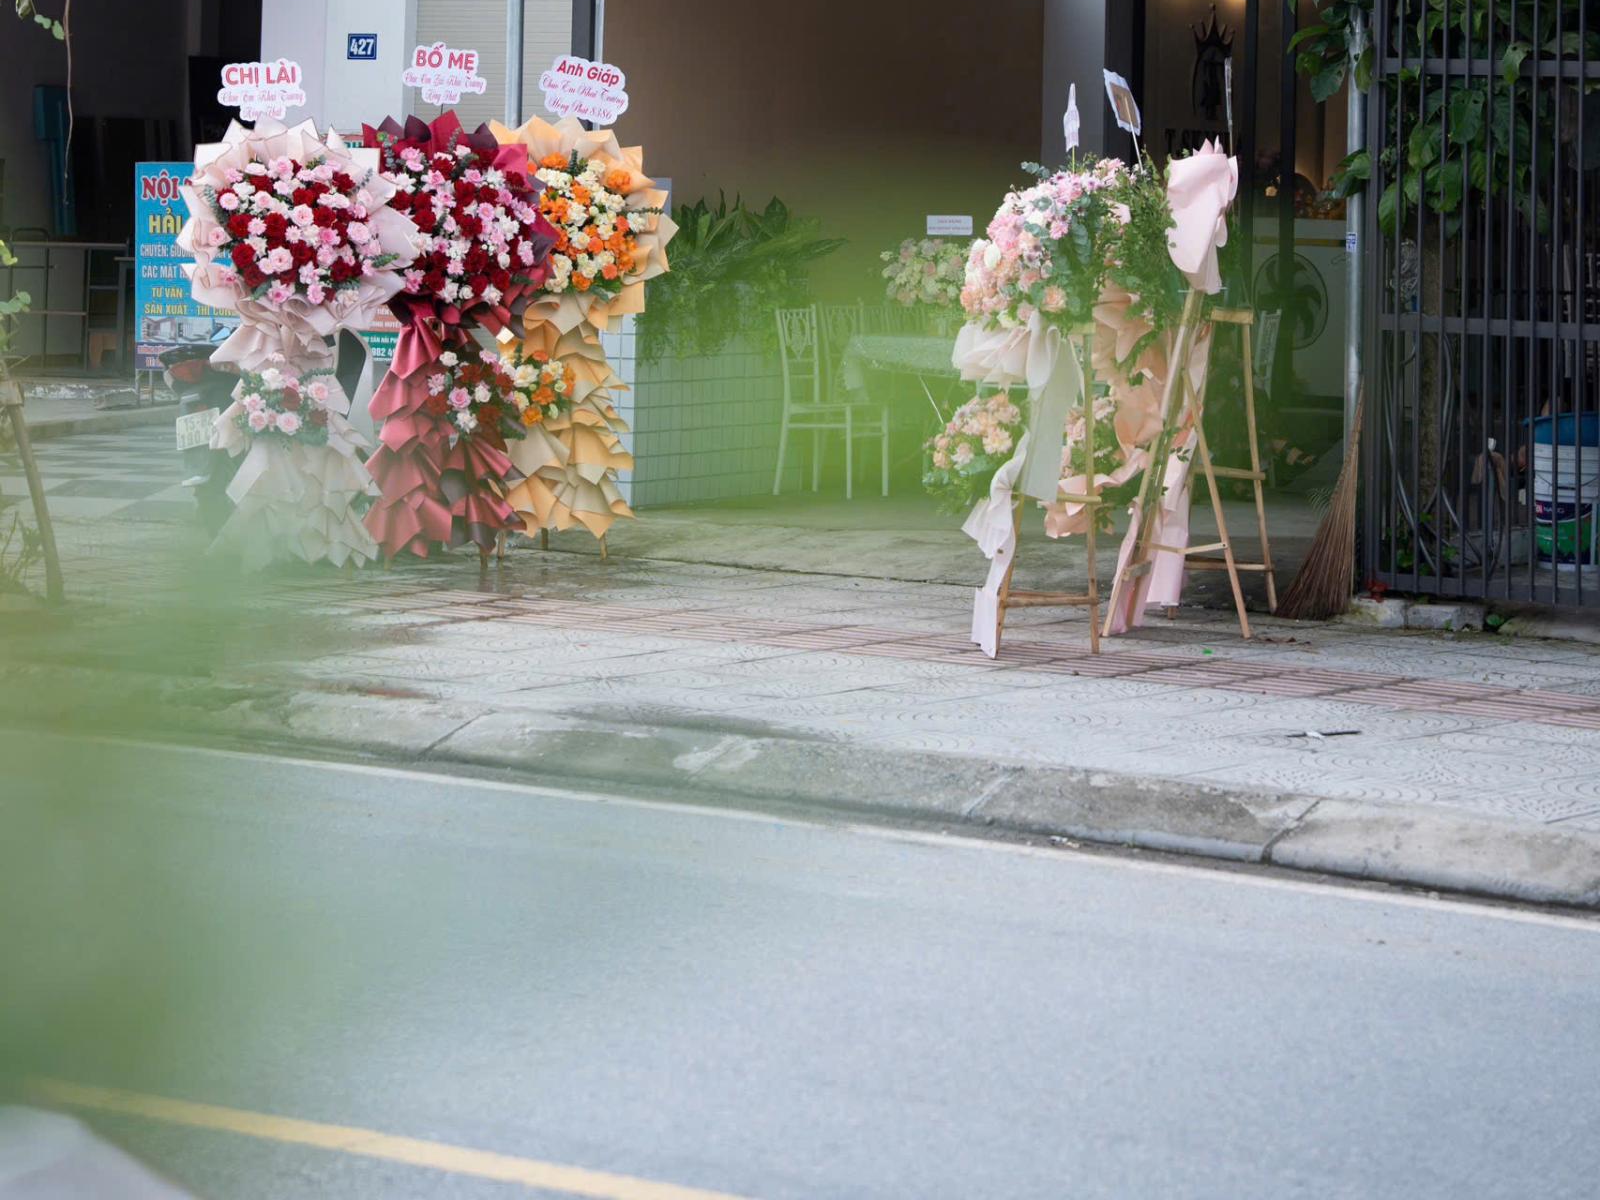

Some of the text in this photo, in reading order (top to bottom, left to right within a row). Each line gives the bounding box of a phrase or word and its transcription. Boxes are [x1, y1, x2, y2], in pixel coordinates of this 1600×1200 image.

[350, 38, 374, 55] 427
[416, 44, 475, 74] BỐ MẸ
[225, 61, 296, 88] CHỊ LÀI
[556, 60, 619, 87] Anh Giáp
[142, 169, 179, 205] NỘI
